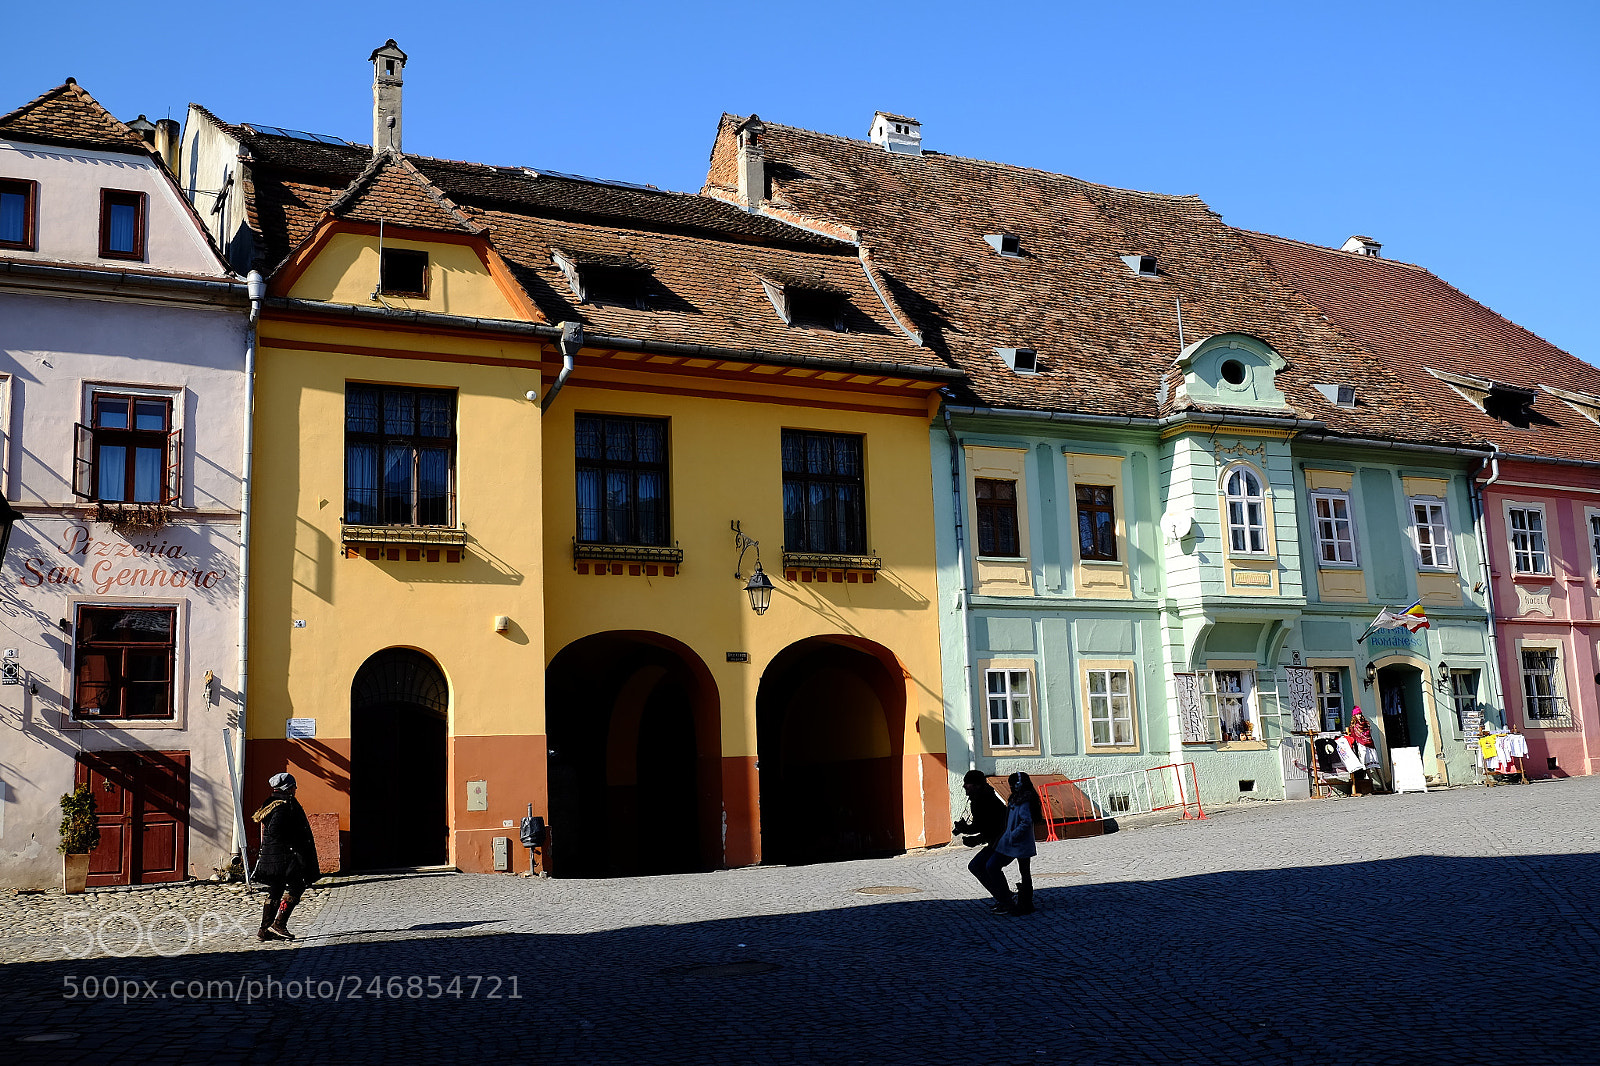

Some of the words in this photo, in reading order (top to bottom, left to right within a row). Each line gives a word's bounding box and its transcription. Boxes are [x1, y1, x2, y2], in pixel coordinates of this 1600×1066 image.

[57, 525, 187, 561] Pizzeria
[20, 557, 82, 588] San
[91, 559, 227, 594] Gennaro
